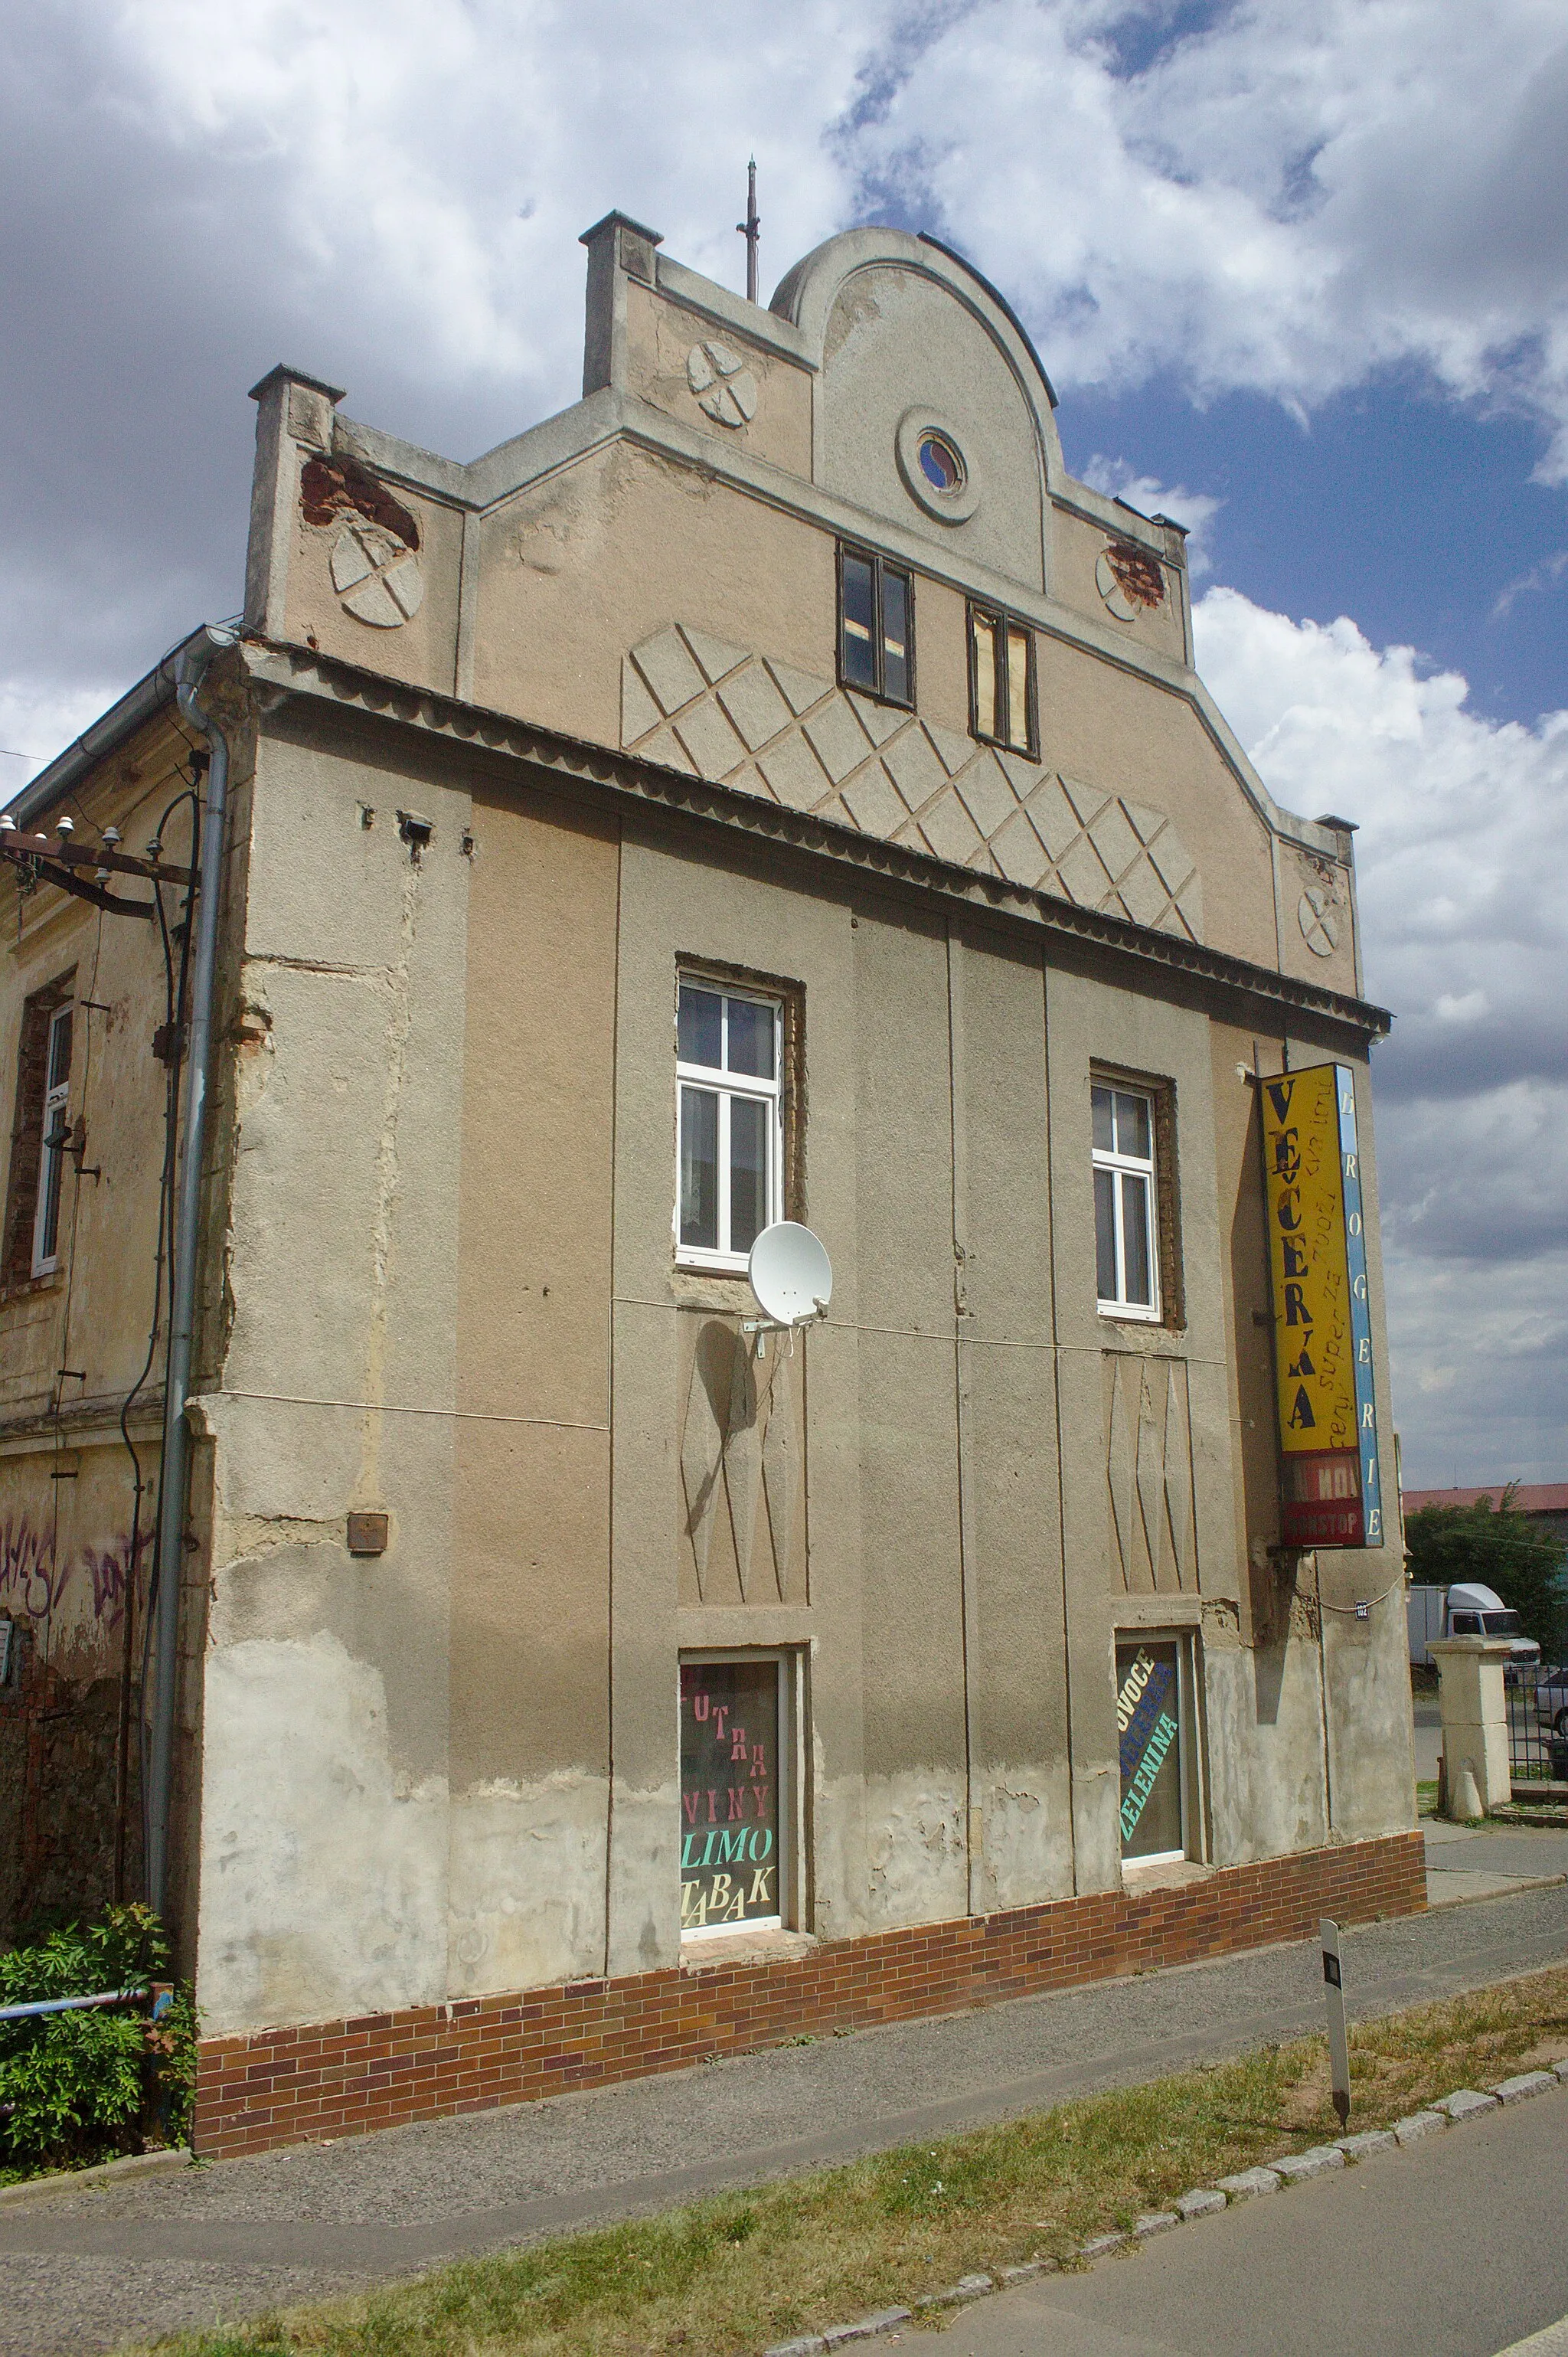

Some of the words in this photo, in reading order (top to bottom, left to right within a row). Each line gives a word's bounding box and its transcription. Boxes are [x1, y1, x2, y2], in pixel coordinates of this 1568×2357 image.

[1341, 1090, 1380, 1535] DROGERIE
[1319, 1308, 1345, 1391] super
[682, 1785, 769, 1824] VINY
[680, 1826, 773, 1869] LIMO
[680, 1865, 776, 1929] TABAK
